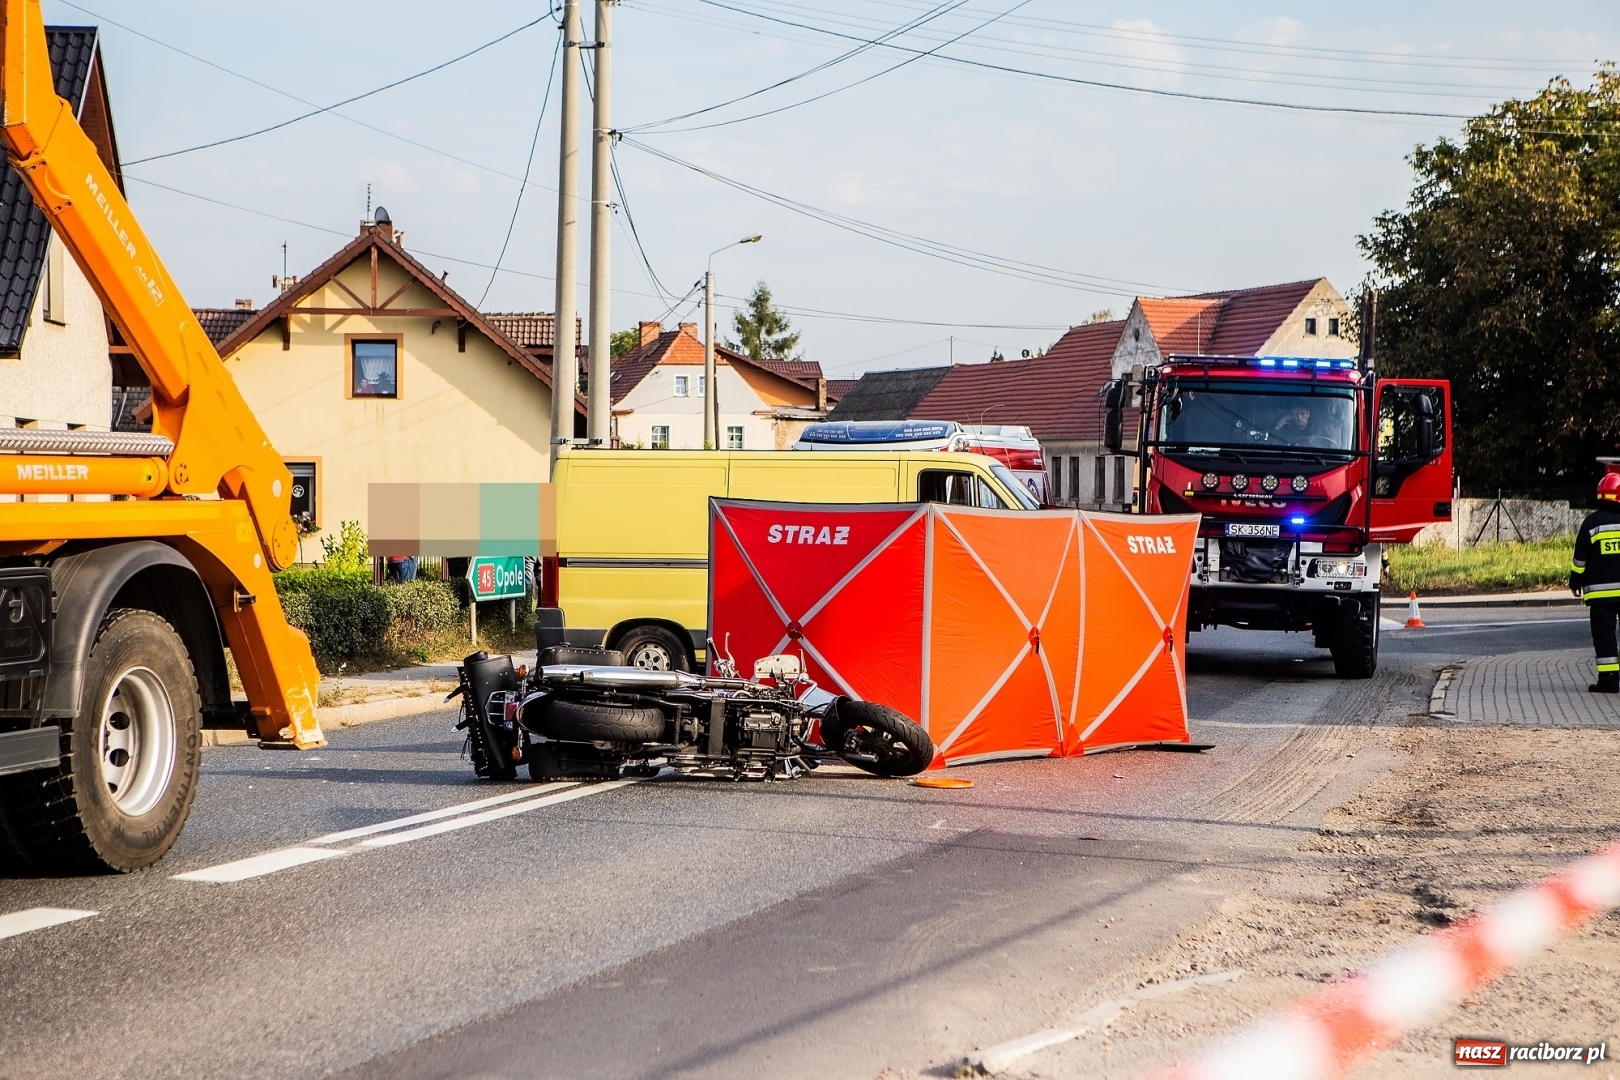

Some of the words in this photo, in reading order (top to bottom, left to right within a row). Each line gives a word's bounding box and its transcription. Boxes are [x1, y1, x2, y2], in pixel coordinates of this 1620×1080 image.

[85, 173, 137, 260] MEILLER
[16, 464, 89, 480] MEILLER
[1231, 525, 1244, 535] SK
[1248, 525, 1278, 536] 356NE
[1604, 541, 1620, 552] ST
[482, 569, 492, 588] 45
[496, 564, 523, 593] Opole
